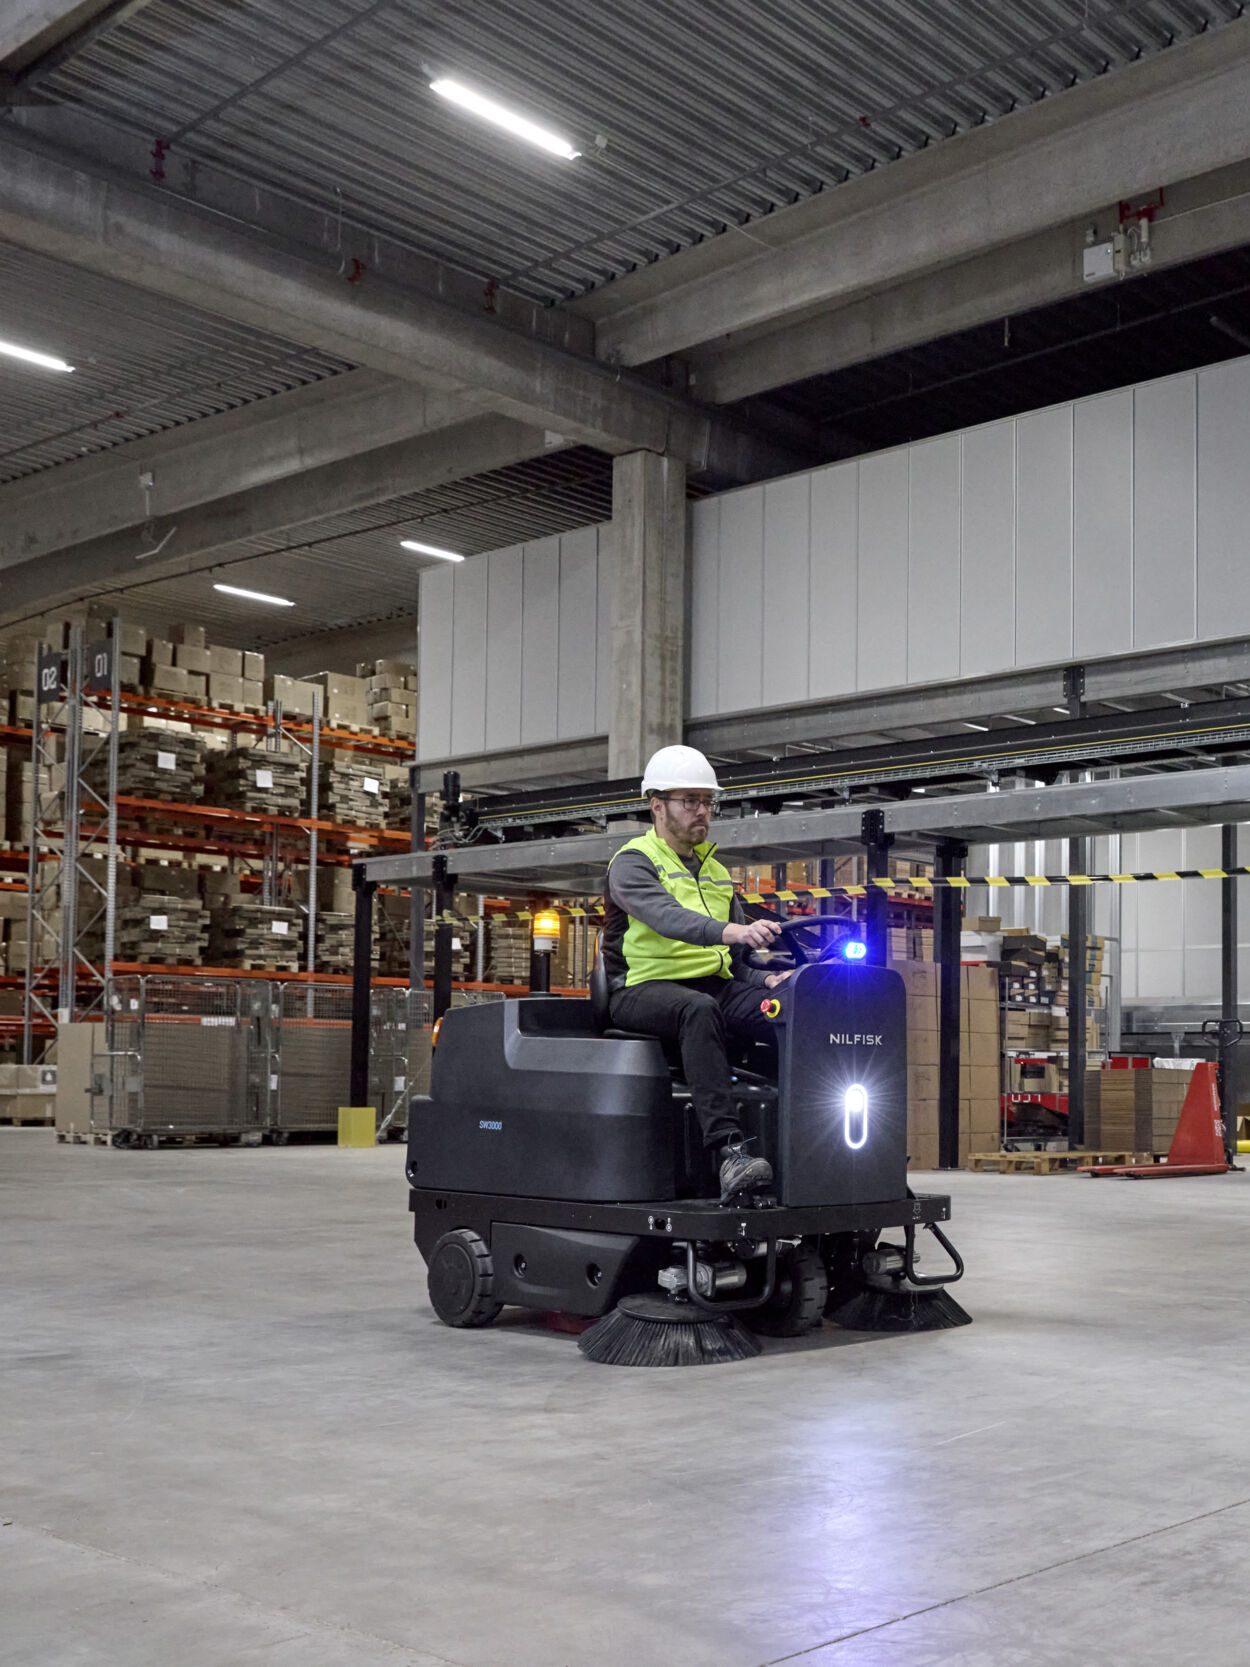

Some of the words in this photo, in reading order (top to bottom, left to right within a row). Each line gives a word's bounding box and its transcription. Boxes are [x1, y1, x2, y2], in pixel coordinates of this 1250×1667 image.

[95, 652, 107, 678] 01
[42, 666, 57, 691] 02
[829, 1033, 883, 1046] NILFISK
[479, 1120, 503, 1130] SW3000
